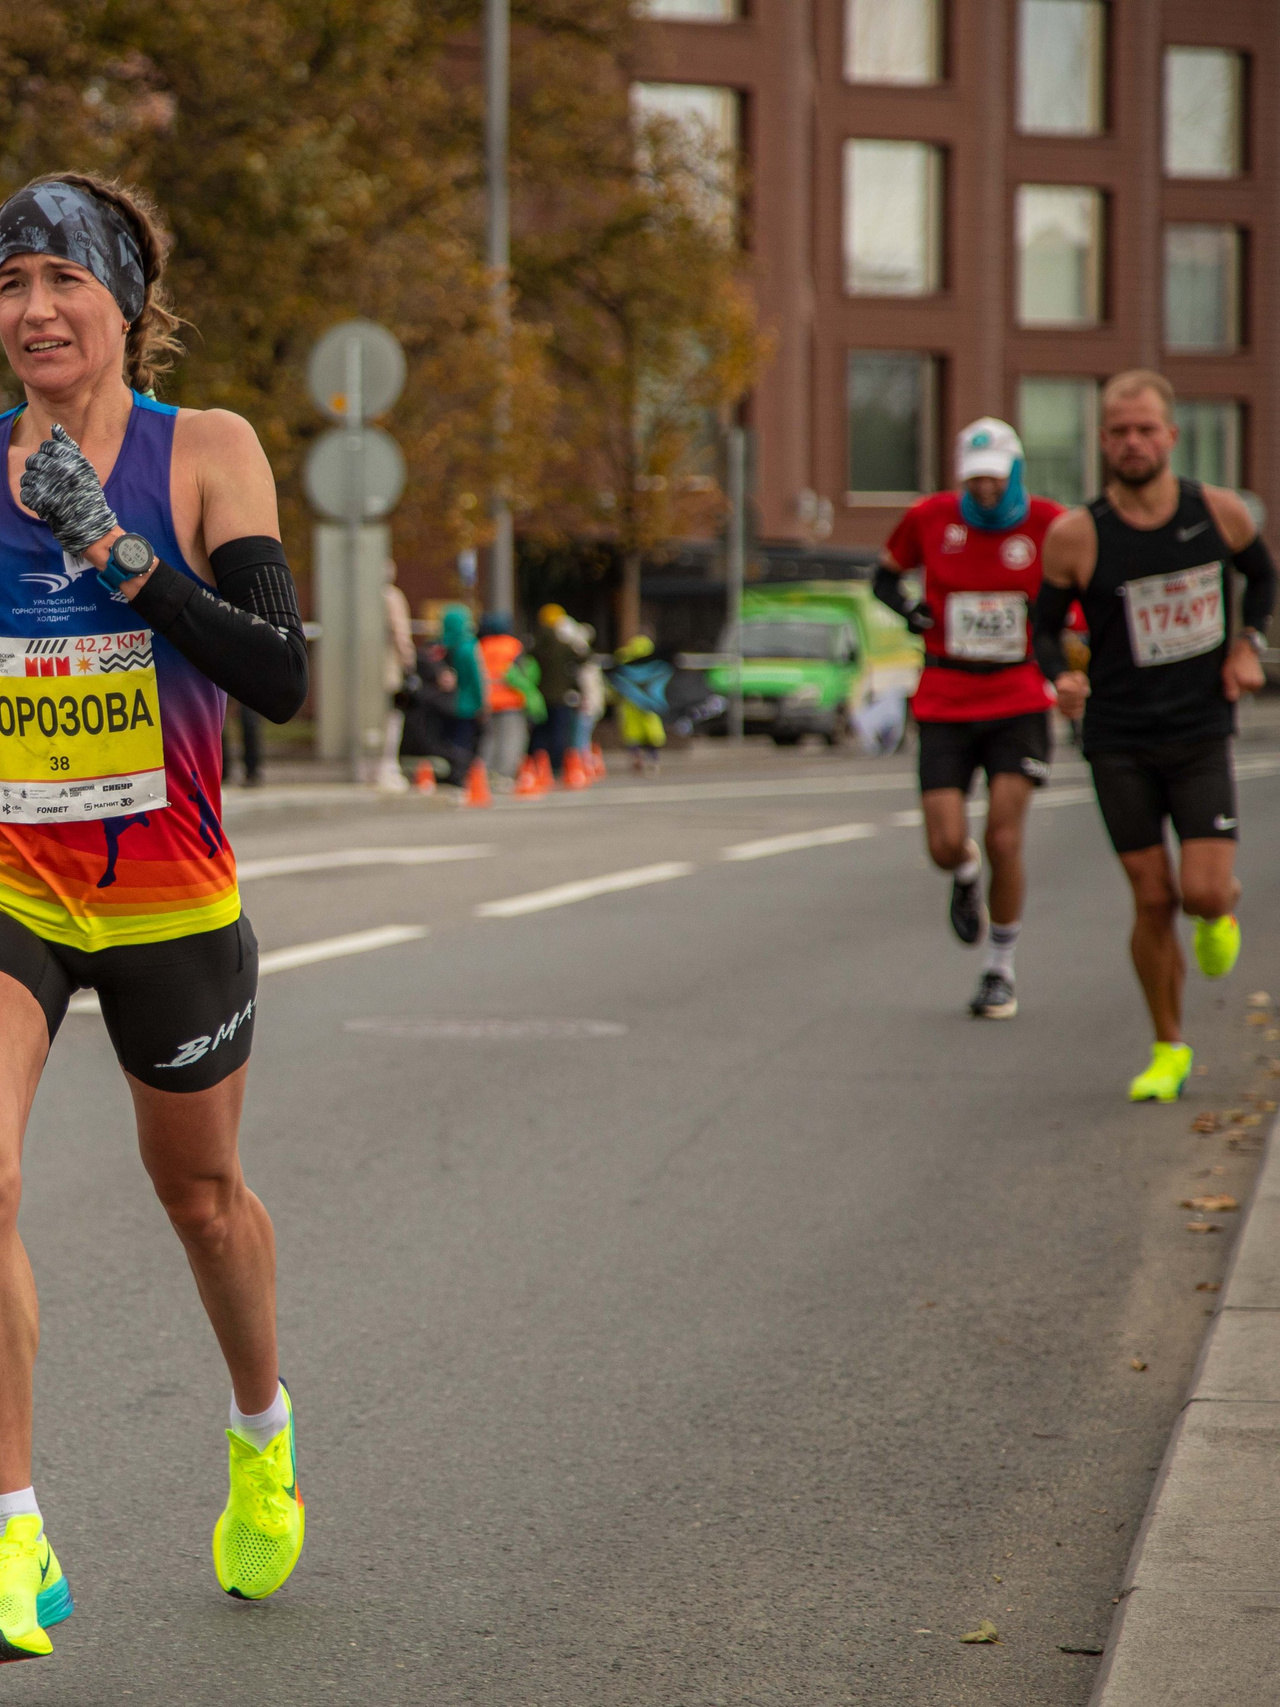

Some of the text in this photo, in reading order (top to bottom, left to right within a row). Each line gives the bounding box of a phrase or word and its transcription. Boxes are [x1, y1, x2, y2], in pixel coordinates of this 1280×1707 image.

[33, 596, 75, 606] УРАЛЬСКИЙ
[12, 604, 97, 615] ГОРНОПРОМЫШЛЕННЫЙ
[74, 632, 146, 654] 42,2 КМ
[49, 756, 70, 771] 38
[102, 783, 133, 792] СИБУР
[36, 806, 69, 814] FONBET
[93, 801, 119, 809] МАГНИТ
